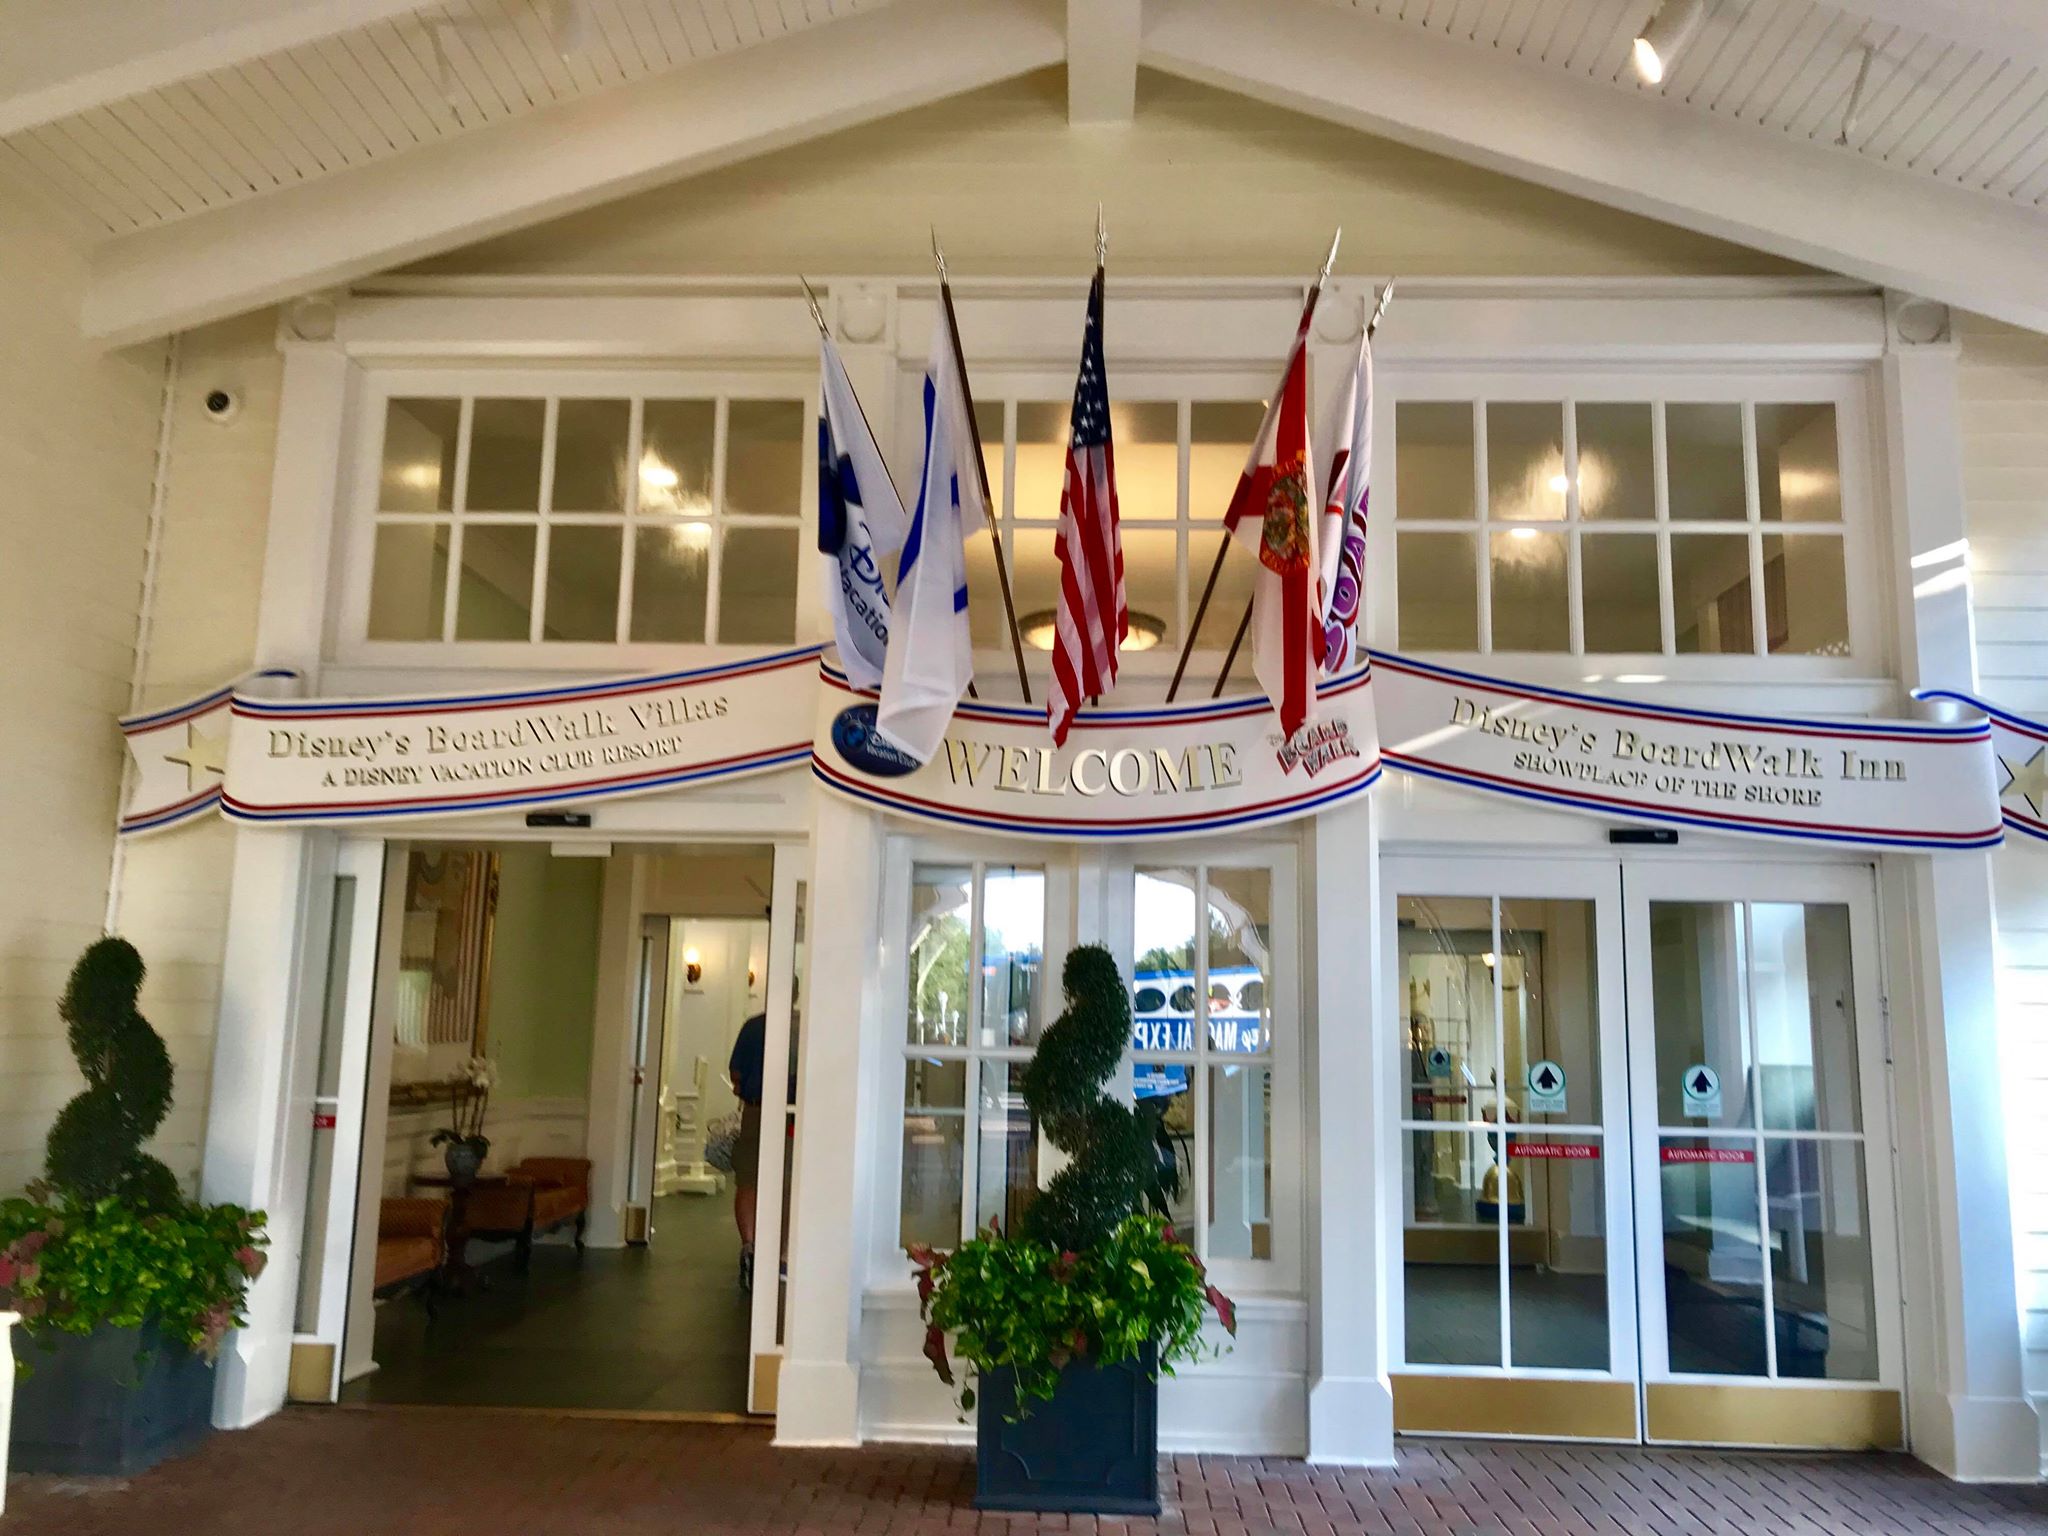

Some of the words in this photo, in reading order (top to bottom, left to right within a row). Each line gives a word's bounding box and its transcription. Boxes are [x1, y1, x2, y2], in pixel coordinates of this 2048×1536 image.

[266, 725, 412, 760] Disney's
[426, 710, 617, 753] BoardWalk
[627, 692, 729, 733] Villas
[1449, 695, 1597, 755] Disney's
[1612, 727, 1824, 780] BoardWalk
[1838, 748, 1909, 783] Inn
[322, 770, 337, 787] A
[344, 763, 424, 787] DISNEY
[430, 757, 534, 783] VACATION
[538, 748, 597, 774] CLUB
[600, 734, 684, 766] RESORT
[943, 737, 1244, 797] WELCOME
[1513, 750, 1648, 788] SHOWPLACE
[1654, 774, 1687, 796] OF
[1691, 778, 1738, 802] THE
[1743, 784, 1823, 808] SHORE
[1514, 1145, 1563, 1157] AUTOMATIC
[1565, 1146, 1591, 1157] DOOR
[1667, 1148, 1716, 1160] AUTOMATIC
[1718, 1150, 1745, 1161] DOOR
